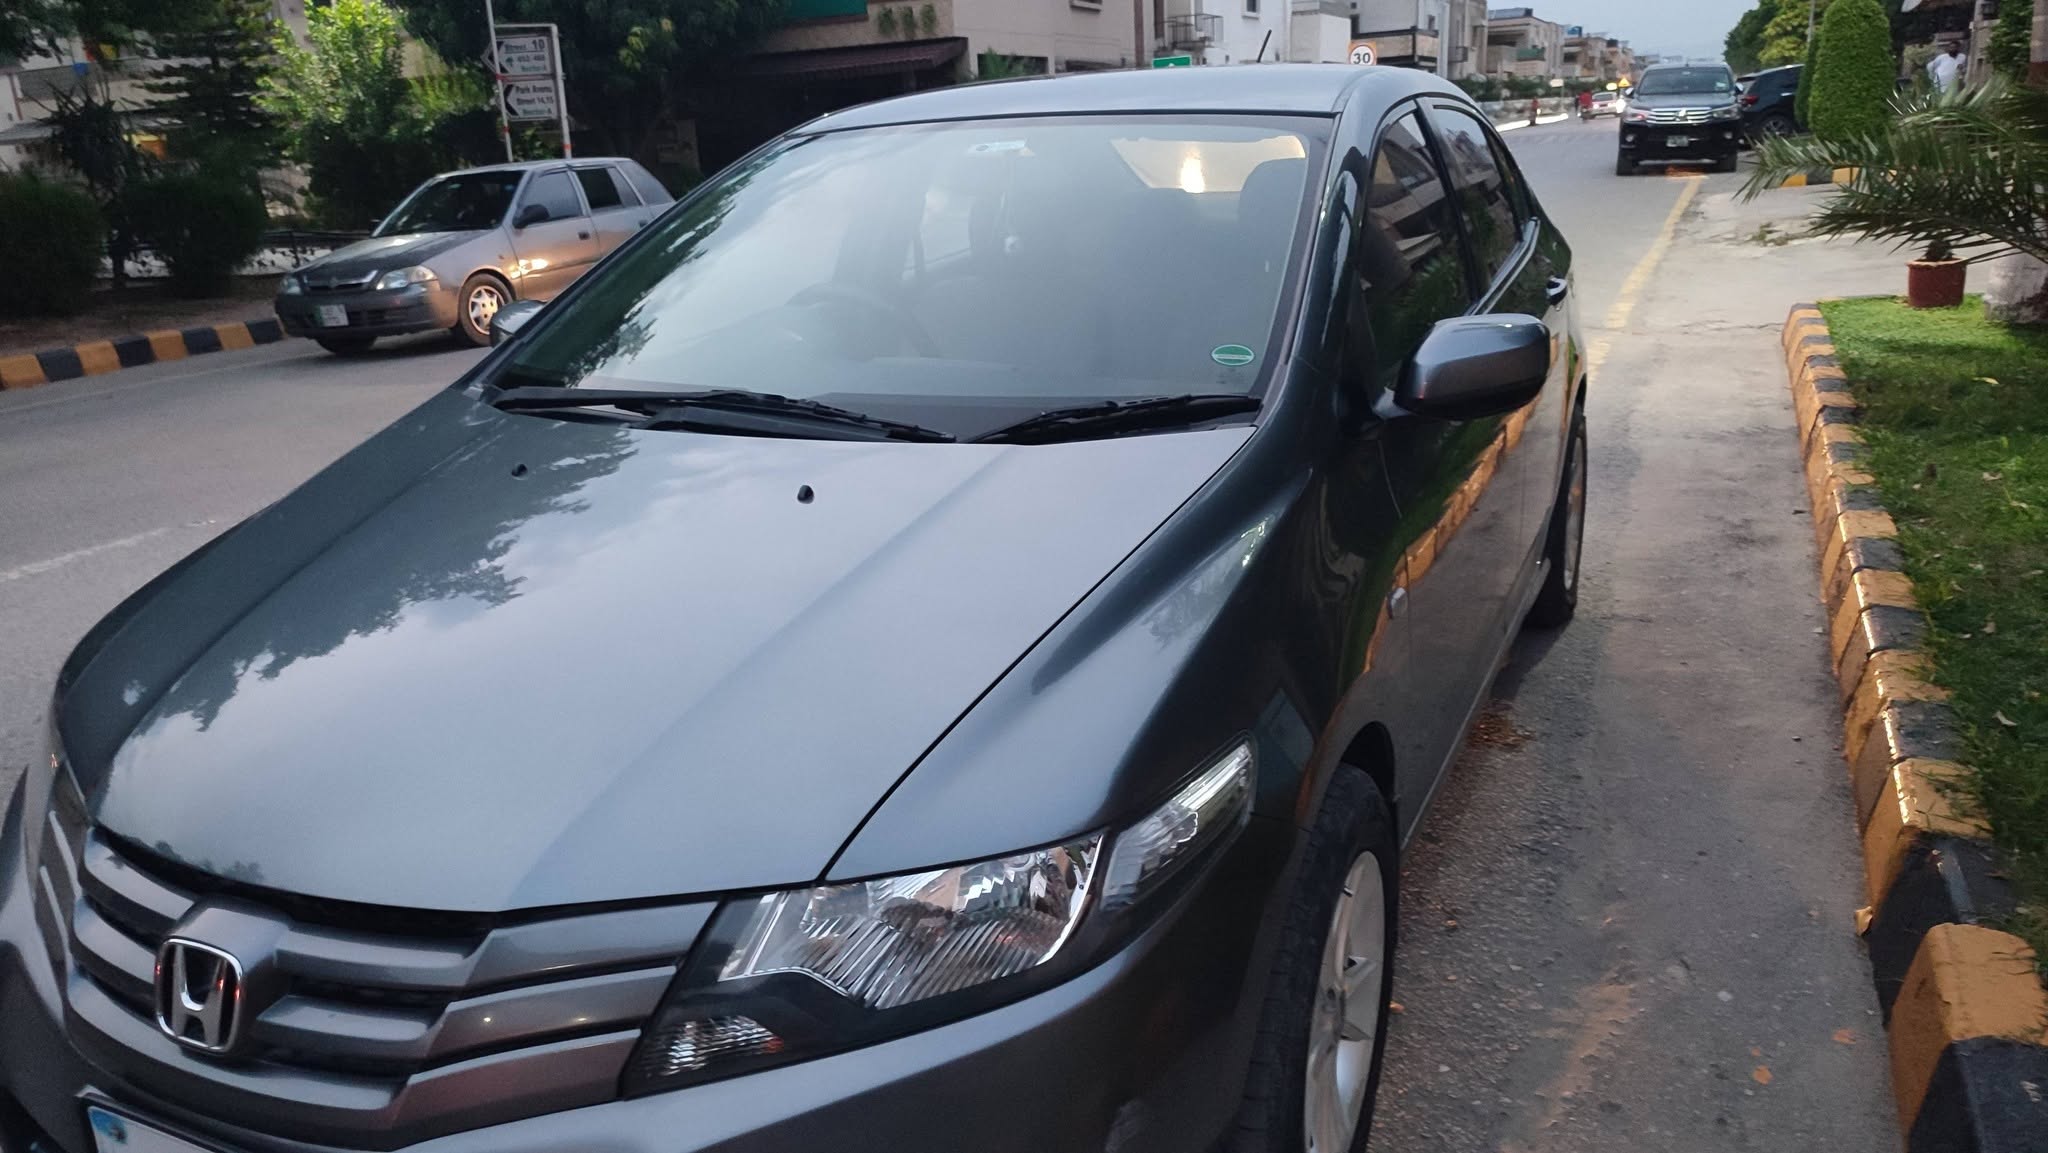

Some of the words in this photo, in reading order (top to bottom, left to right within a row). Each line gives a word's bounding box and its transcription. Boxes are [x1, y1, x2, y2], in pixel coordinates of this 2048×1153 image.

[532, 39, 545, 50] 10
[1353, 52, 1371, 65] 30
[516, 85, 530, 95] Park
[517, 97, 536, 106] Street
